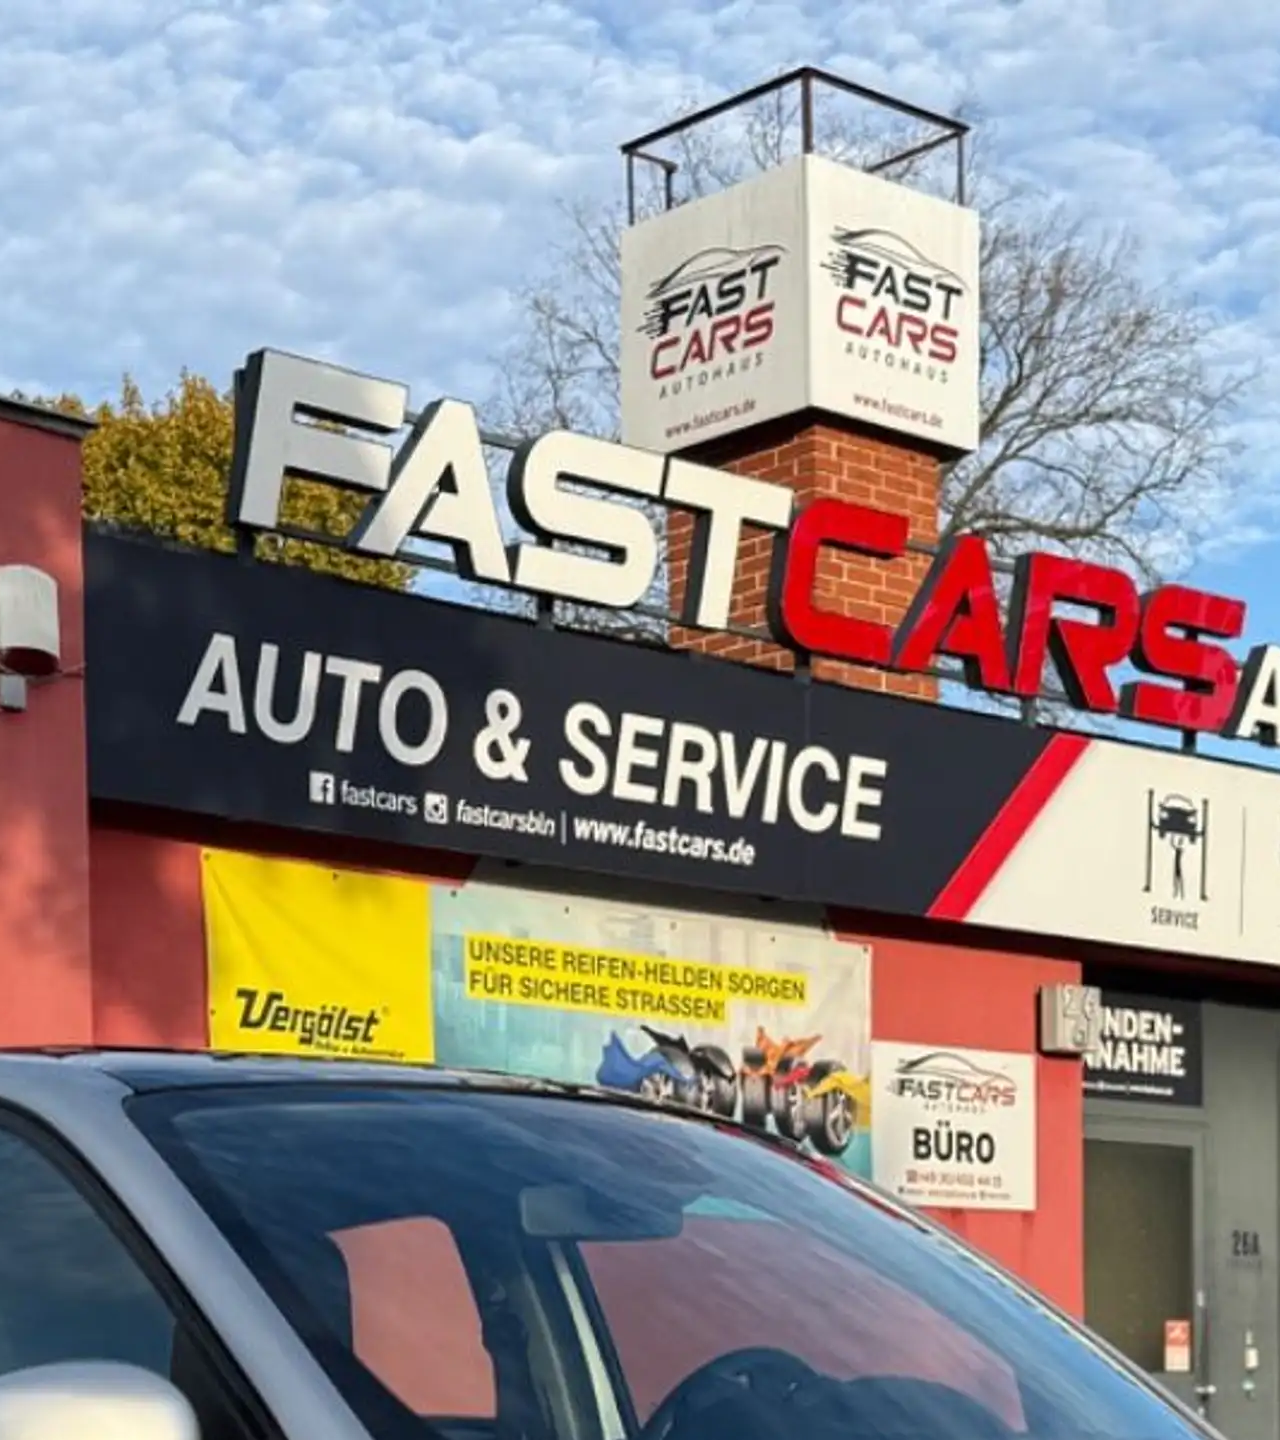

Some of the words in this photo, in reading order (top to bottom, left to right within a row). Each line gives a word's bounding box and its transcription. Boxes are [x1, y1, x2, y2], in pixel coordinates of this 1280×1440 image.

[660, 256, 780, 335] FAST
[842, 250, 963, 321] FAST
[651, 301, 775, 379] CARS
[836, 295, 958, 363] CARS
[658, 351, 764, 400] AUTOHAUS
[845, 341, 948, 385] AUTOHAUS
[665, 397, 756, 438] www.fastcars.de
[853, 392, 943, 427] www.fastcars.de
[176, 632, 449, 766] AUTO
[473, 688, 532, 781] &
[559, 702, 888, 842] SERVICE
[339, 778, 419, 815] fastcars
[573, 815, 756, 867] www.fastcars.de
[1150, 905, 1199, 931] SERVICE
[468, 938, 557, 970] UNSERE
[562, 950, 723, 990] REIFEN-HELDEN
[727, 970, 806, 1002] SORGEN
[469, 965, 514, 996] FÜR
[520, 980, 611, 1009] SICHERE
[615, 988, 726, 1021] STRASSEN!
[235, 987, 380, 1046] Vergölst
[912, 1118, 995, 1165] BÜRO
